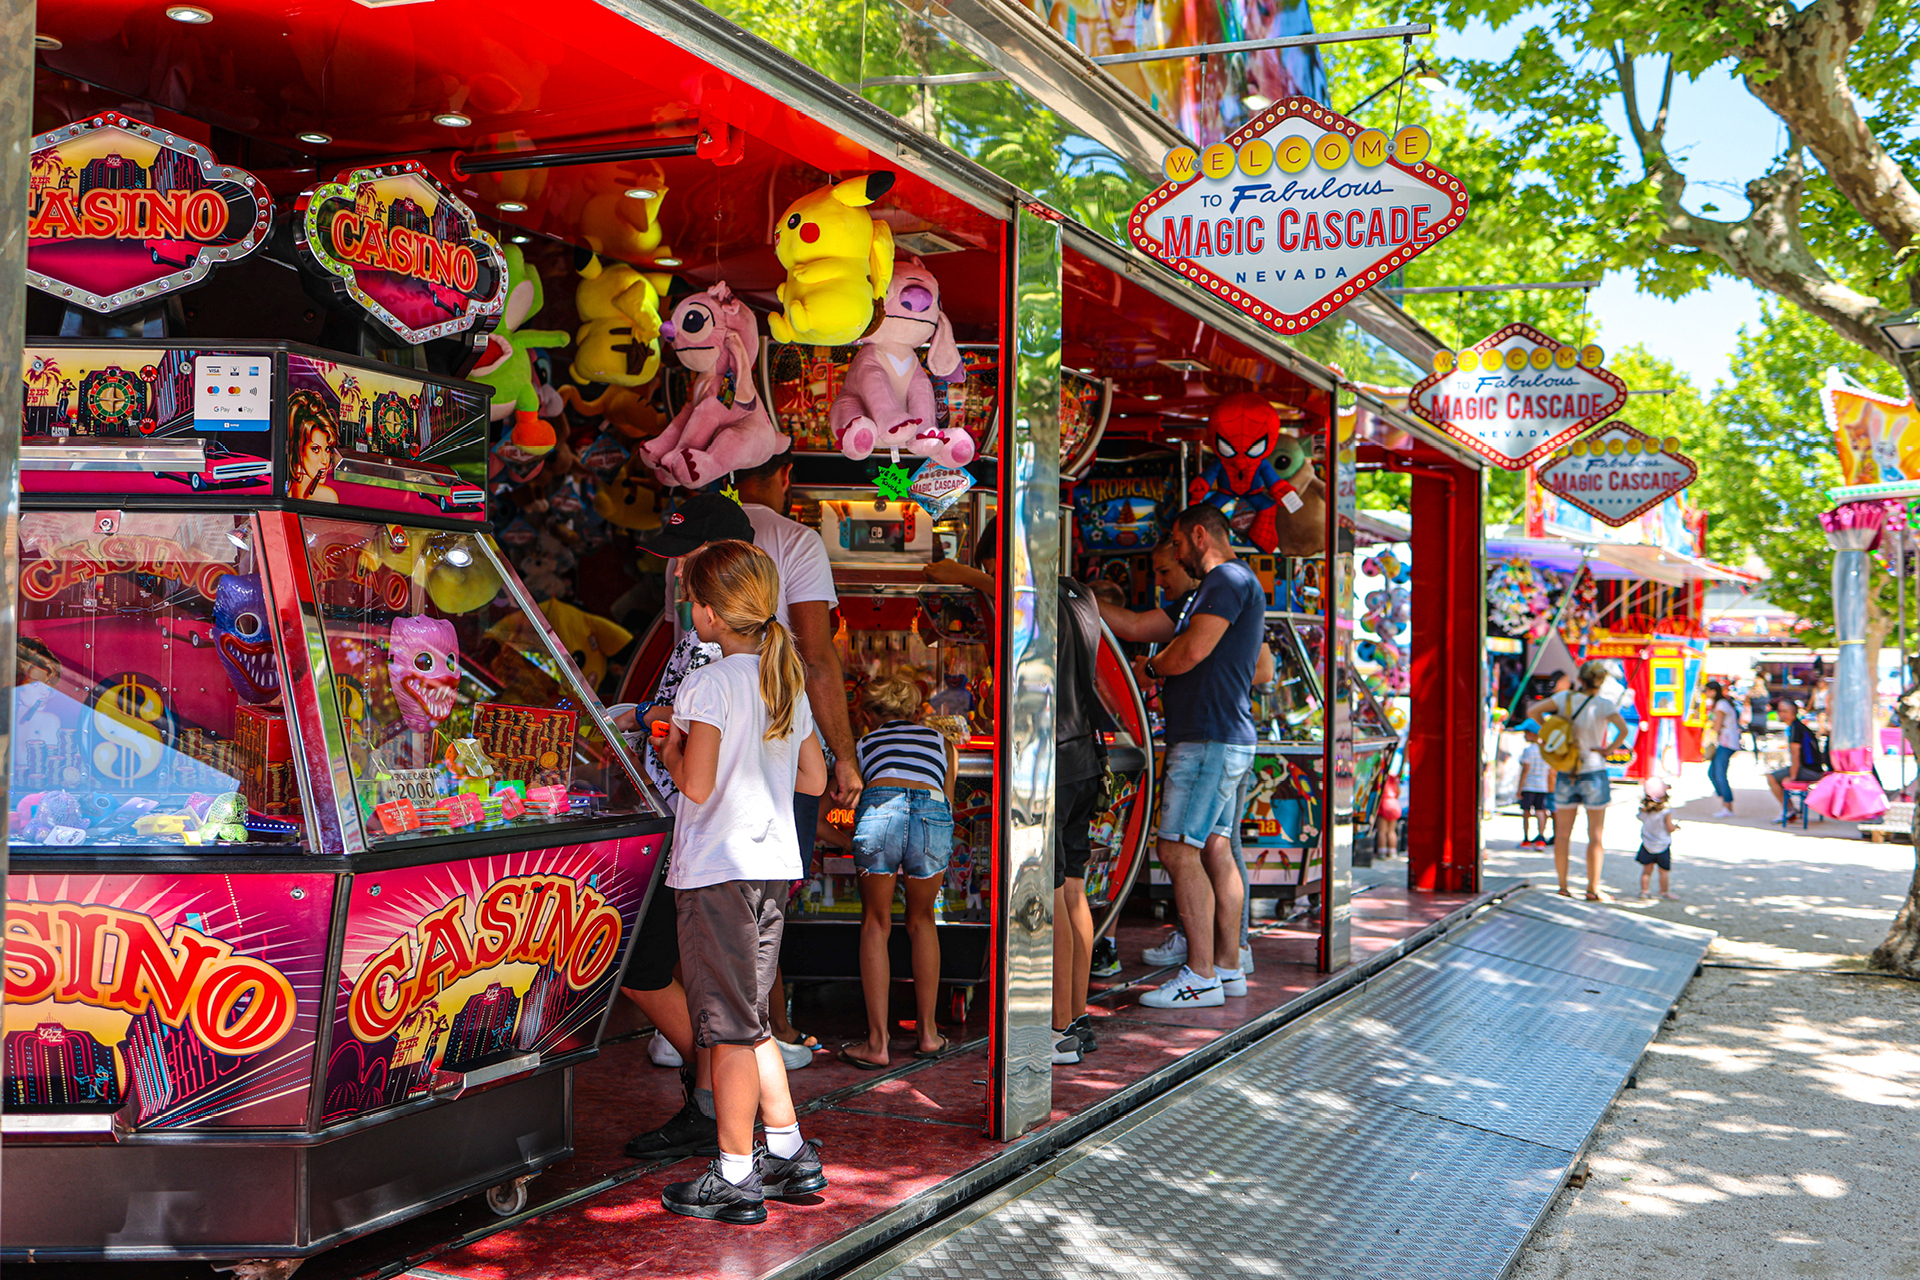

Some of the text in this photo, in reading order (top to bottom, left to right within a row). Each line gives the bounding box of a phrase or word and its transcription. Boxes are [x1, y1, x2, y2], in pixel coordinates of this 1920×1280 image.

[1169, 136, 1418, 174] WELCOME
[1200, 177, 1394, 214] TO Fabulous
[28, 187, 229, 240] ASINO
[1162, 204, 1431, 260] MAGIC CASCADE
[331, 209, 478, 293] CASINO
[1236, 266, 1347, 283] NEVADA
[1436, 349, 1597, 369] WELCOME
[1457, 373, 1581, 394] TO Fabulous
[1430, 391, 1604, 421] MAGIC CASCADE
[1479, 429, 1551, 438] NEVADA
[912, 482, 933, 493] MAGIC
[934, 479, 966, 491] CASCADE
[1088, 477, 1164, 504] TROPICANA
[1552, 471, 1681, 492] MAGIC CASCADE
[19, 533, 241, 602] CASINO
[397, 782, 435, 799] 2000
[348, 873, 623, 1043] CASINO
